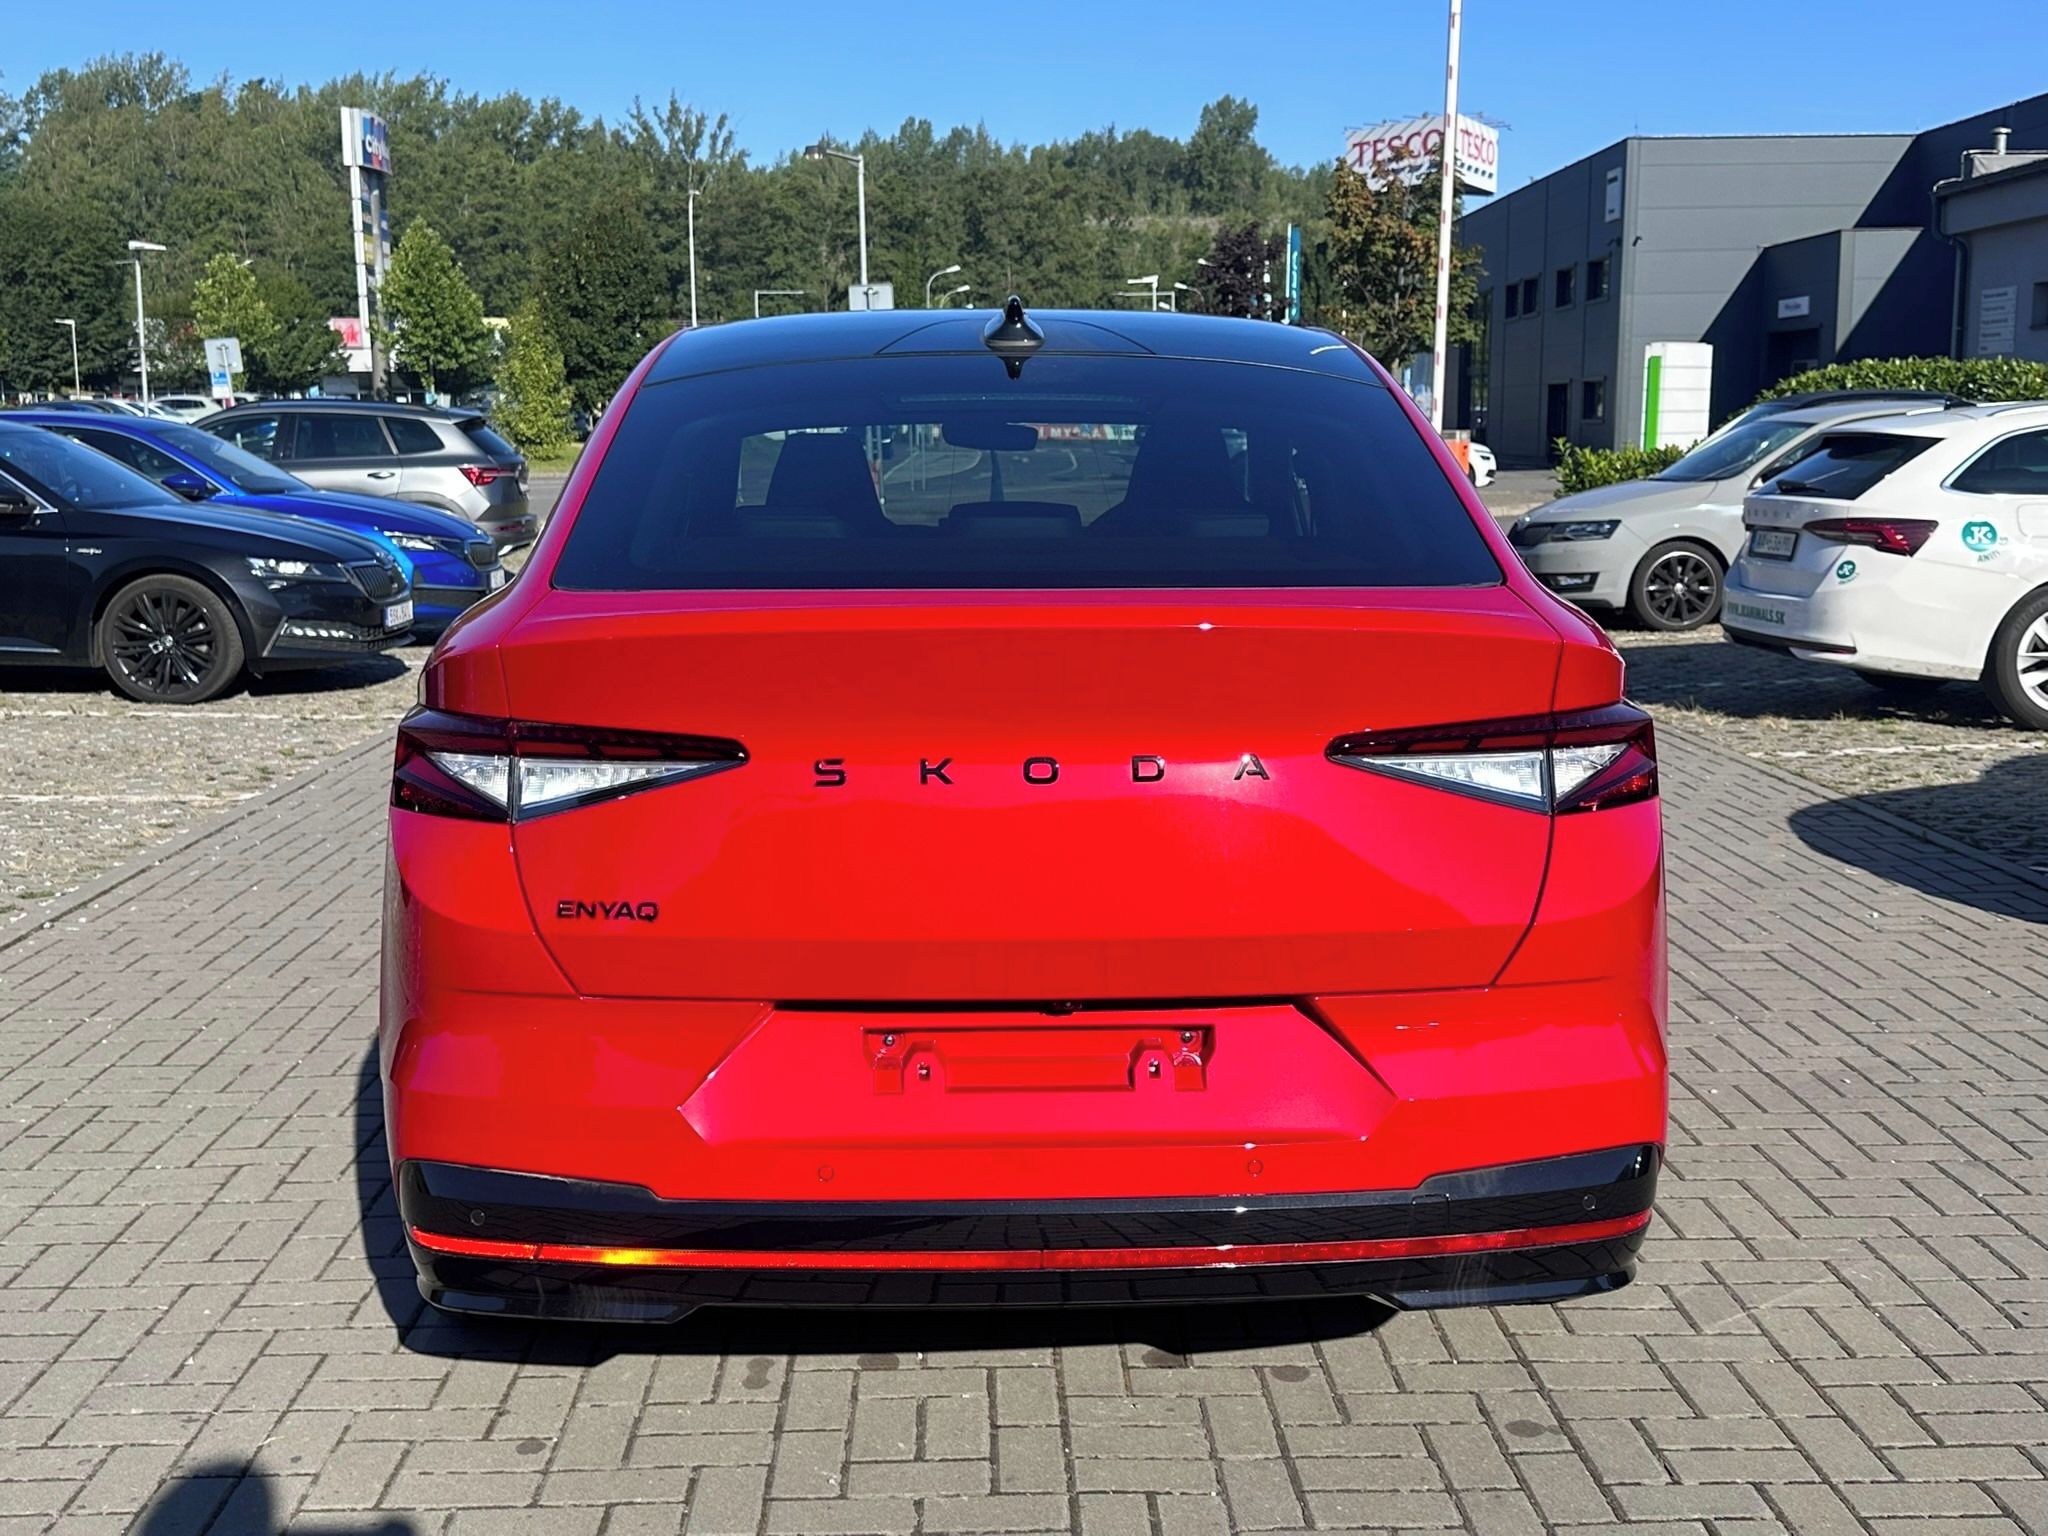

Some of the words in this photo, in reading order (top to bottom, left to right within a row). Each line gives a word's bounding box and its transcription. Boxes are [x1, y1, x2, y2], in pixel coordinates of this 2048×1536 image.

[1352, 129, 1444, 167] TESCO
[1459, 128, 1496, 166] TESCO
[813, 753, 1271, 788] SKODA
[557, 900, 659, 922] ENYAQ
